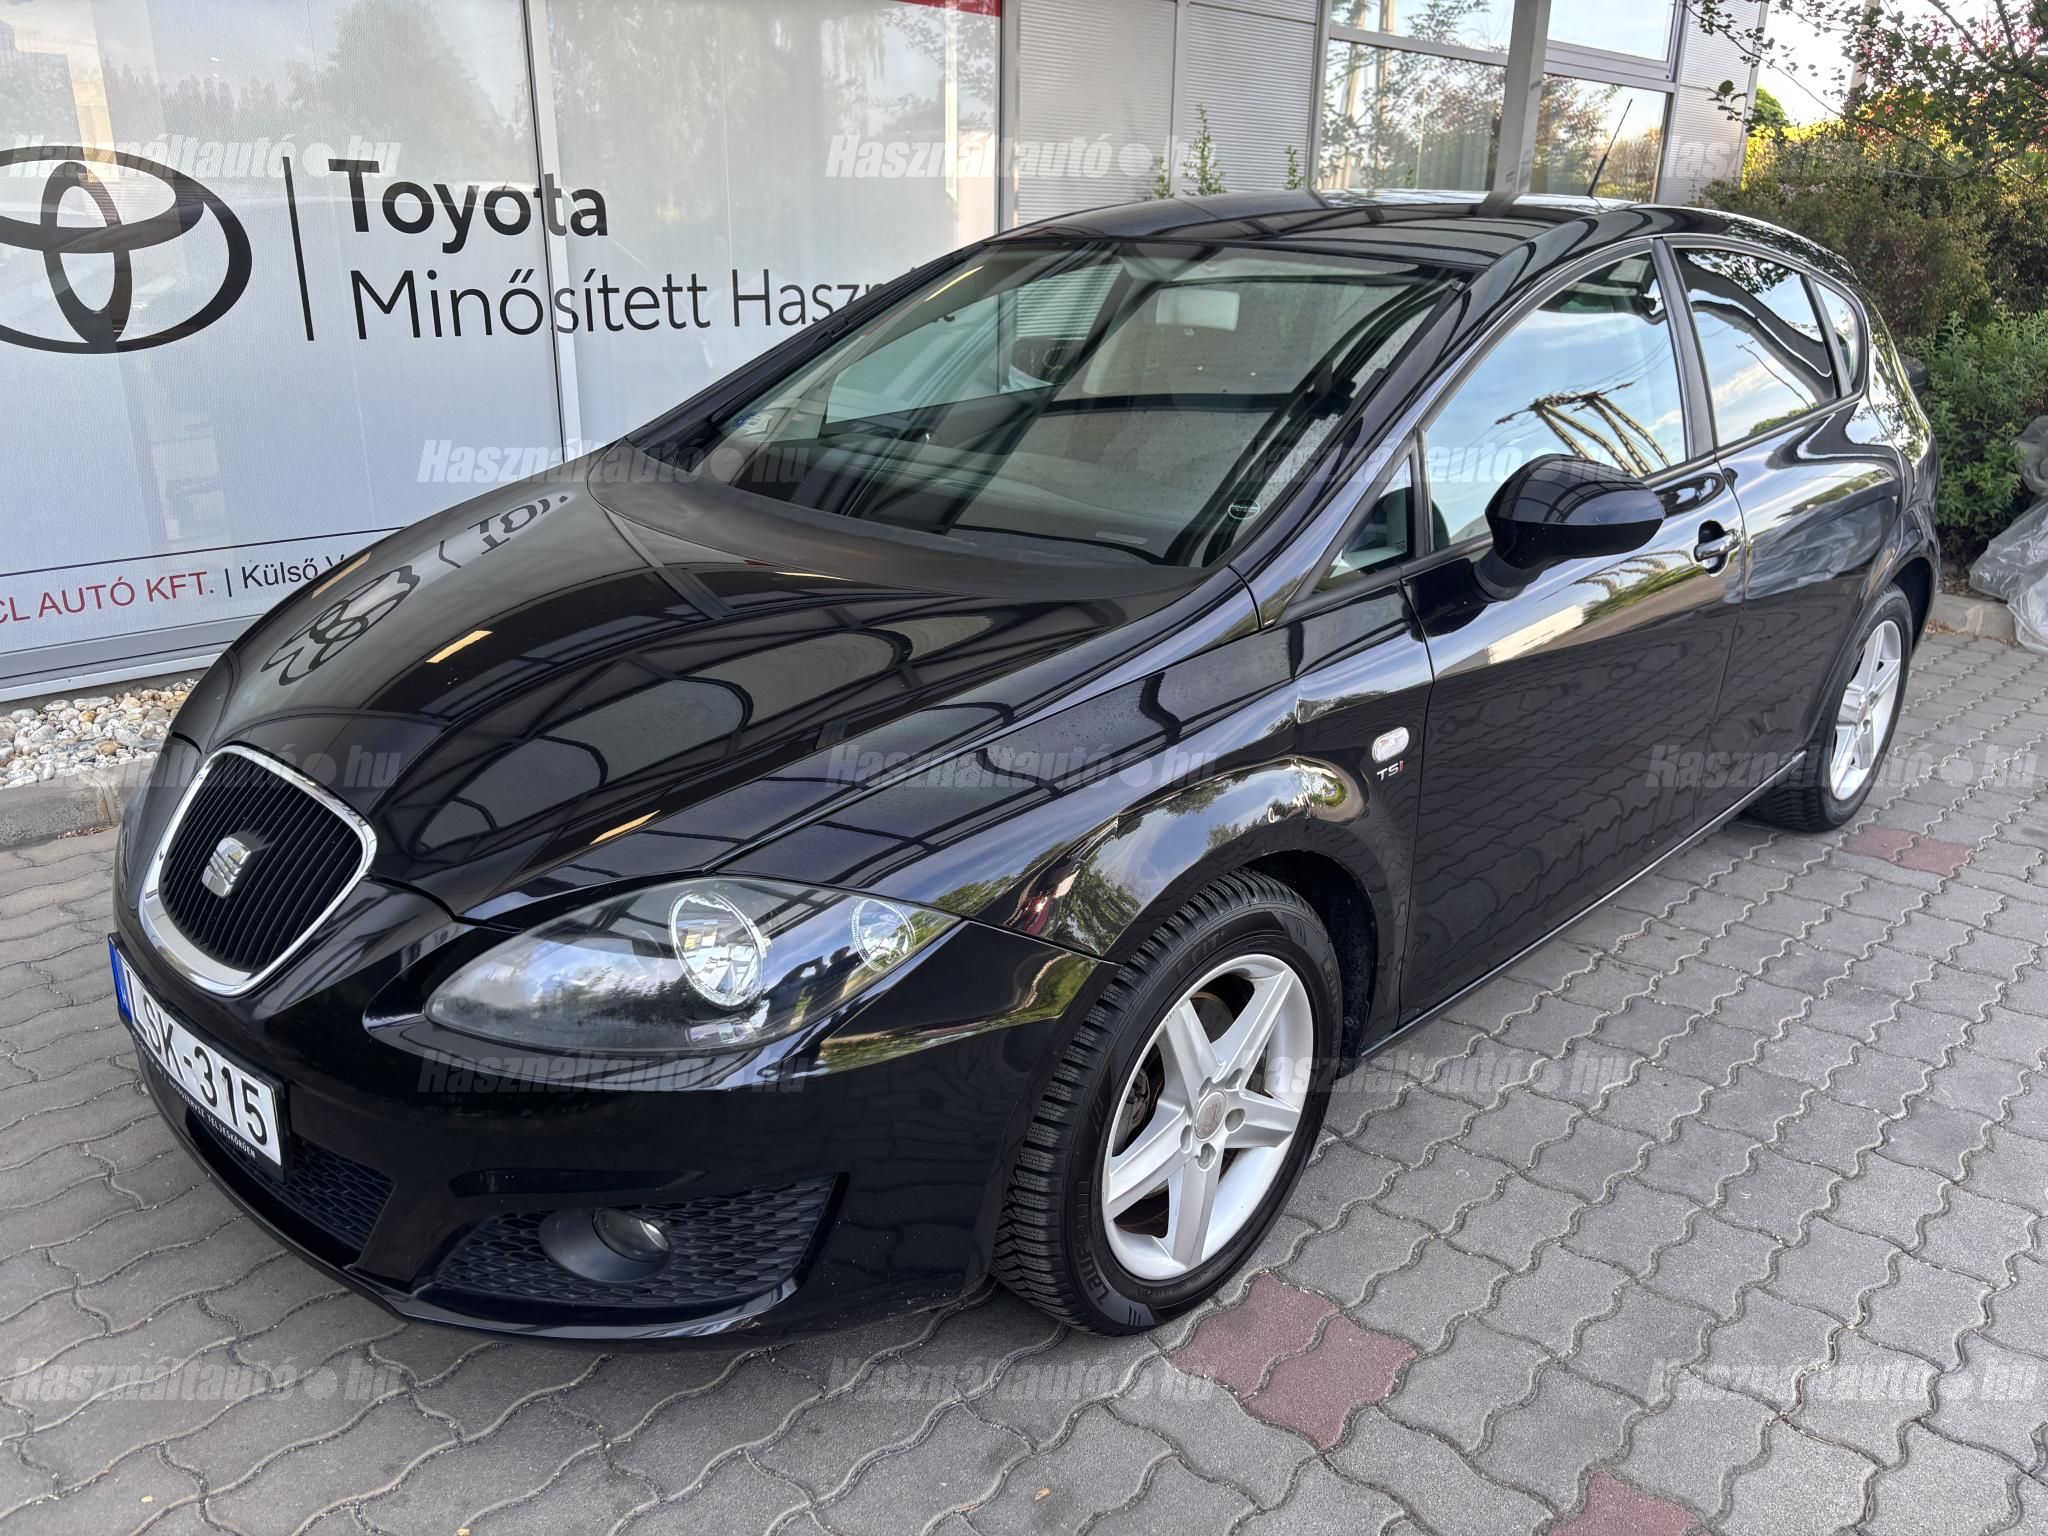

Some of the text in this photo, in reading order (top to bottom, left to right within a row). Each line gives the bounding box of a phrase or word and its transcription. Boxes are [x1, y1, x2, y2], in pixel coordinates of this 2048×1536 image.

[329, 158, 608, 254] Toyota
[350, 268, 711, 340] Minősített
[38, 577, 136, 617] AUTÓ
[146, 572, 214, 603] KFT.
[243, 557, 318, 590] Külső
[1376, 760, 1405, 781] TSI
[126, 969, 268, 1146] LSK-315
